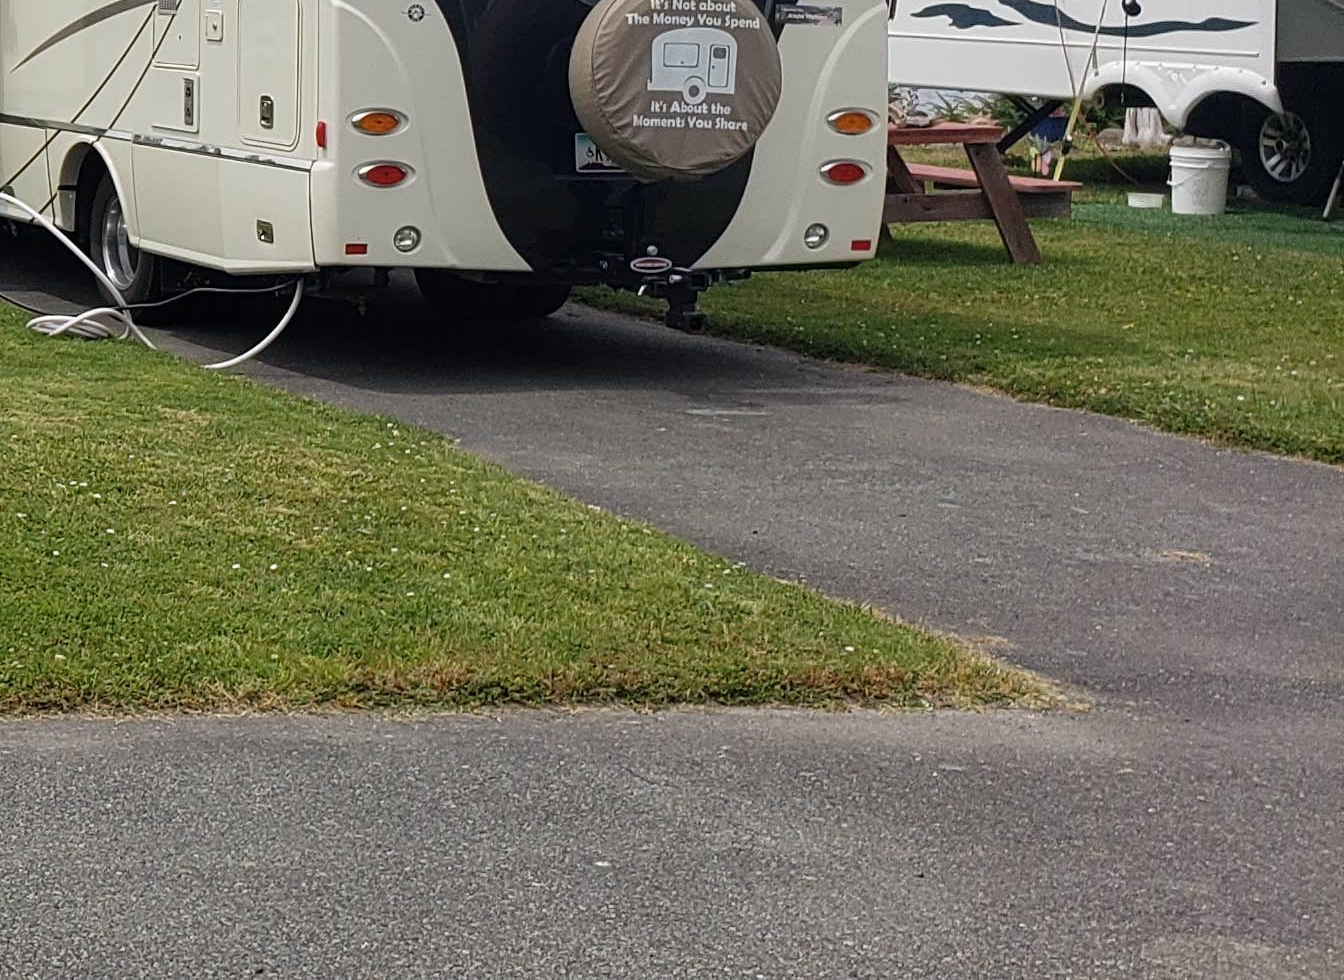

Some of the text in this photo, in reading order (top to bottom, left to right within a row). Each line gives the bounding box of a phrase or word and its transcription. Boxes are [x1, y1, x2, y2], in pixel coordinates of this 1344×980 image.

[699, 0, 737, 13] about
[625, 12, 761, 29] The Money You Spend
[650, 100, 732, 115] It's About the
[632, 114, 748, 131] Moments You Share
